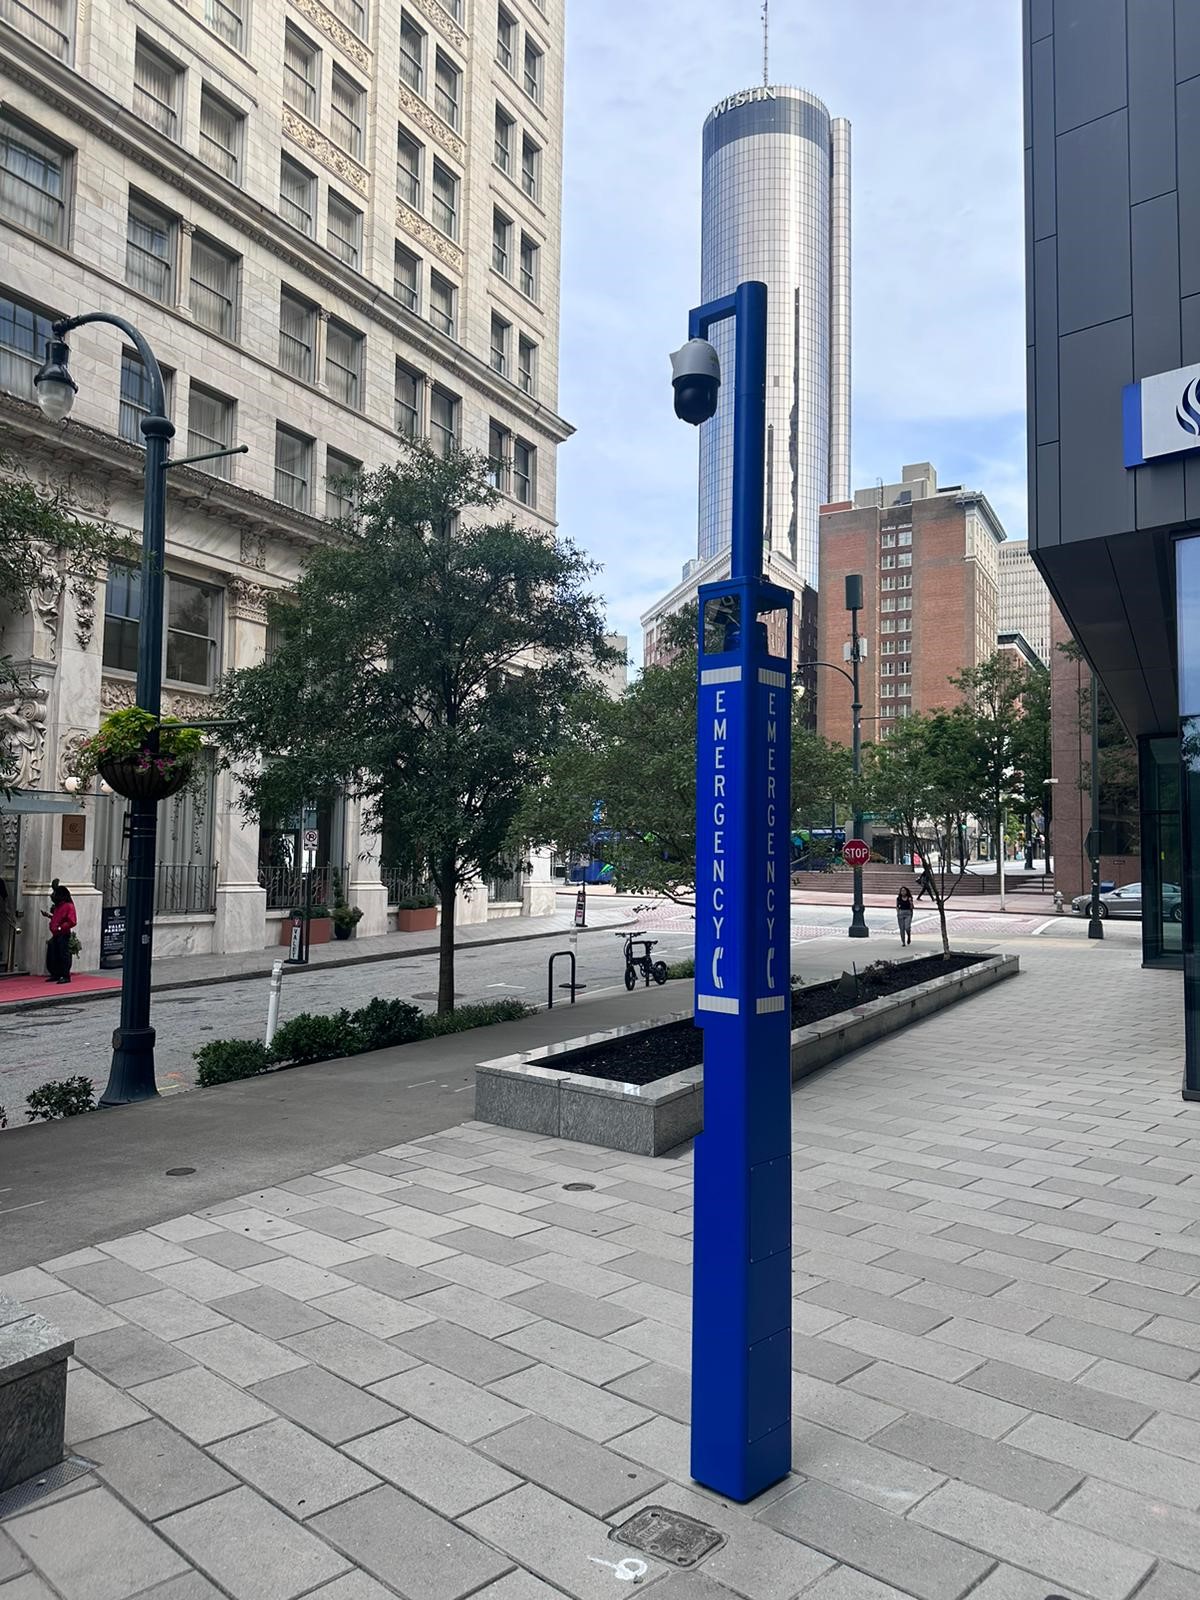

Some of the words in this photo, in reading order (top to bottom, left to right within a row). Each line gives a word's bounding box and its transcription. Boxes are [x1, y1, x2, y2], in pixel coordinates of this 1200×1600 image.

[711, 87, 777, 118] WESTIN
[712, 690, 727, 939] EMERGENCY
[767, 693, 776, 940] EMERGENCY
[845, 848, 868, 858] STOP
